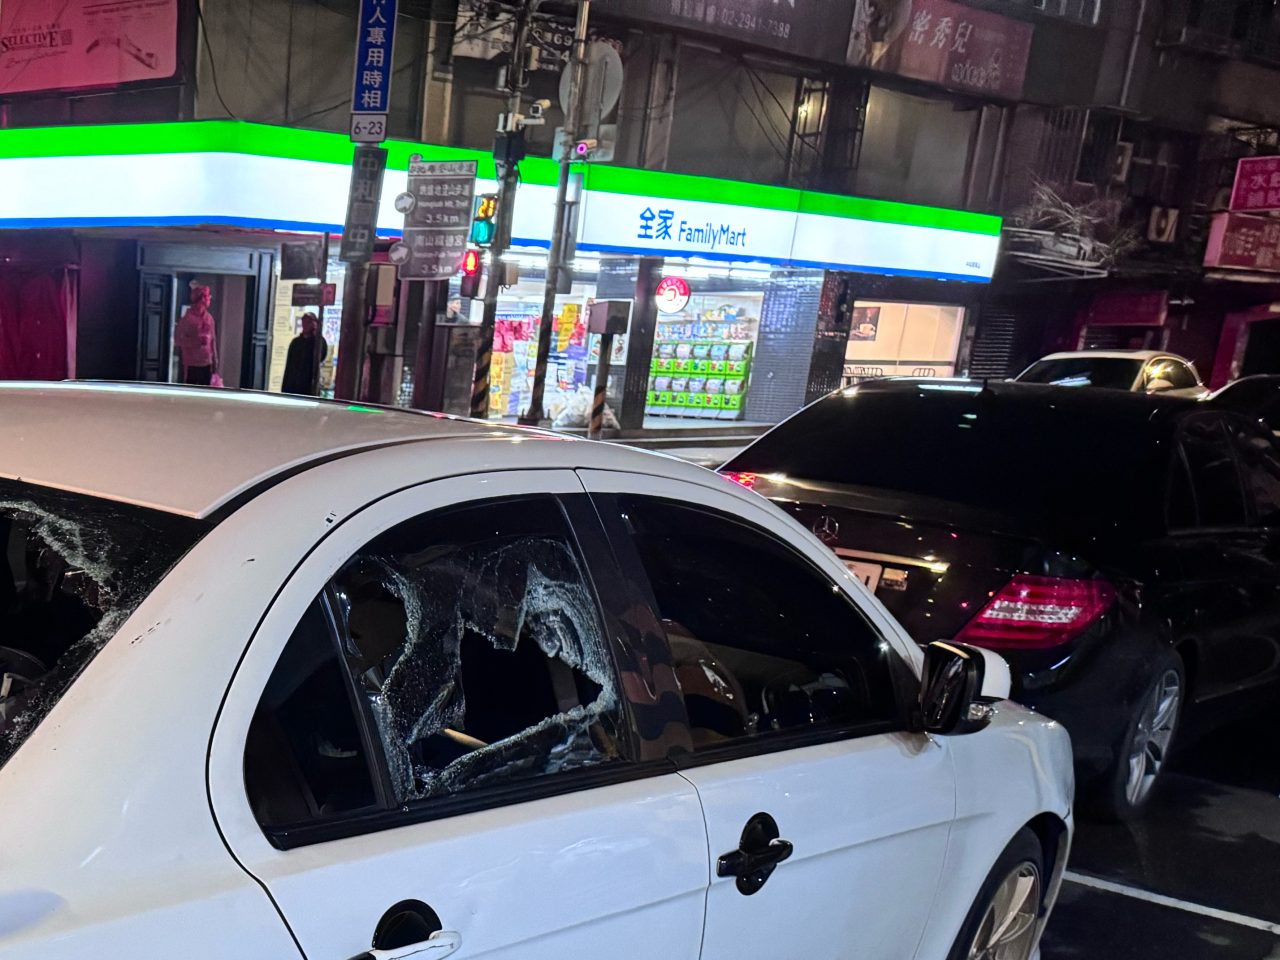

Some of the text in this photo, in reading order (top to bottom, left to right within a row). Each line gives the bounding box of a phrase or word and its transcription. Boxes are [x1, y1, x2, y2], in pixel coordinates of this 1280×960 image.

[362, 0, 388, 108] 人專用時相
[353, 121, 383, 135] 6-23
[638, 206, 674, 240] 全家
[678, 220, 747, 250] FamilyMart
